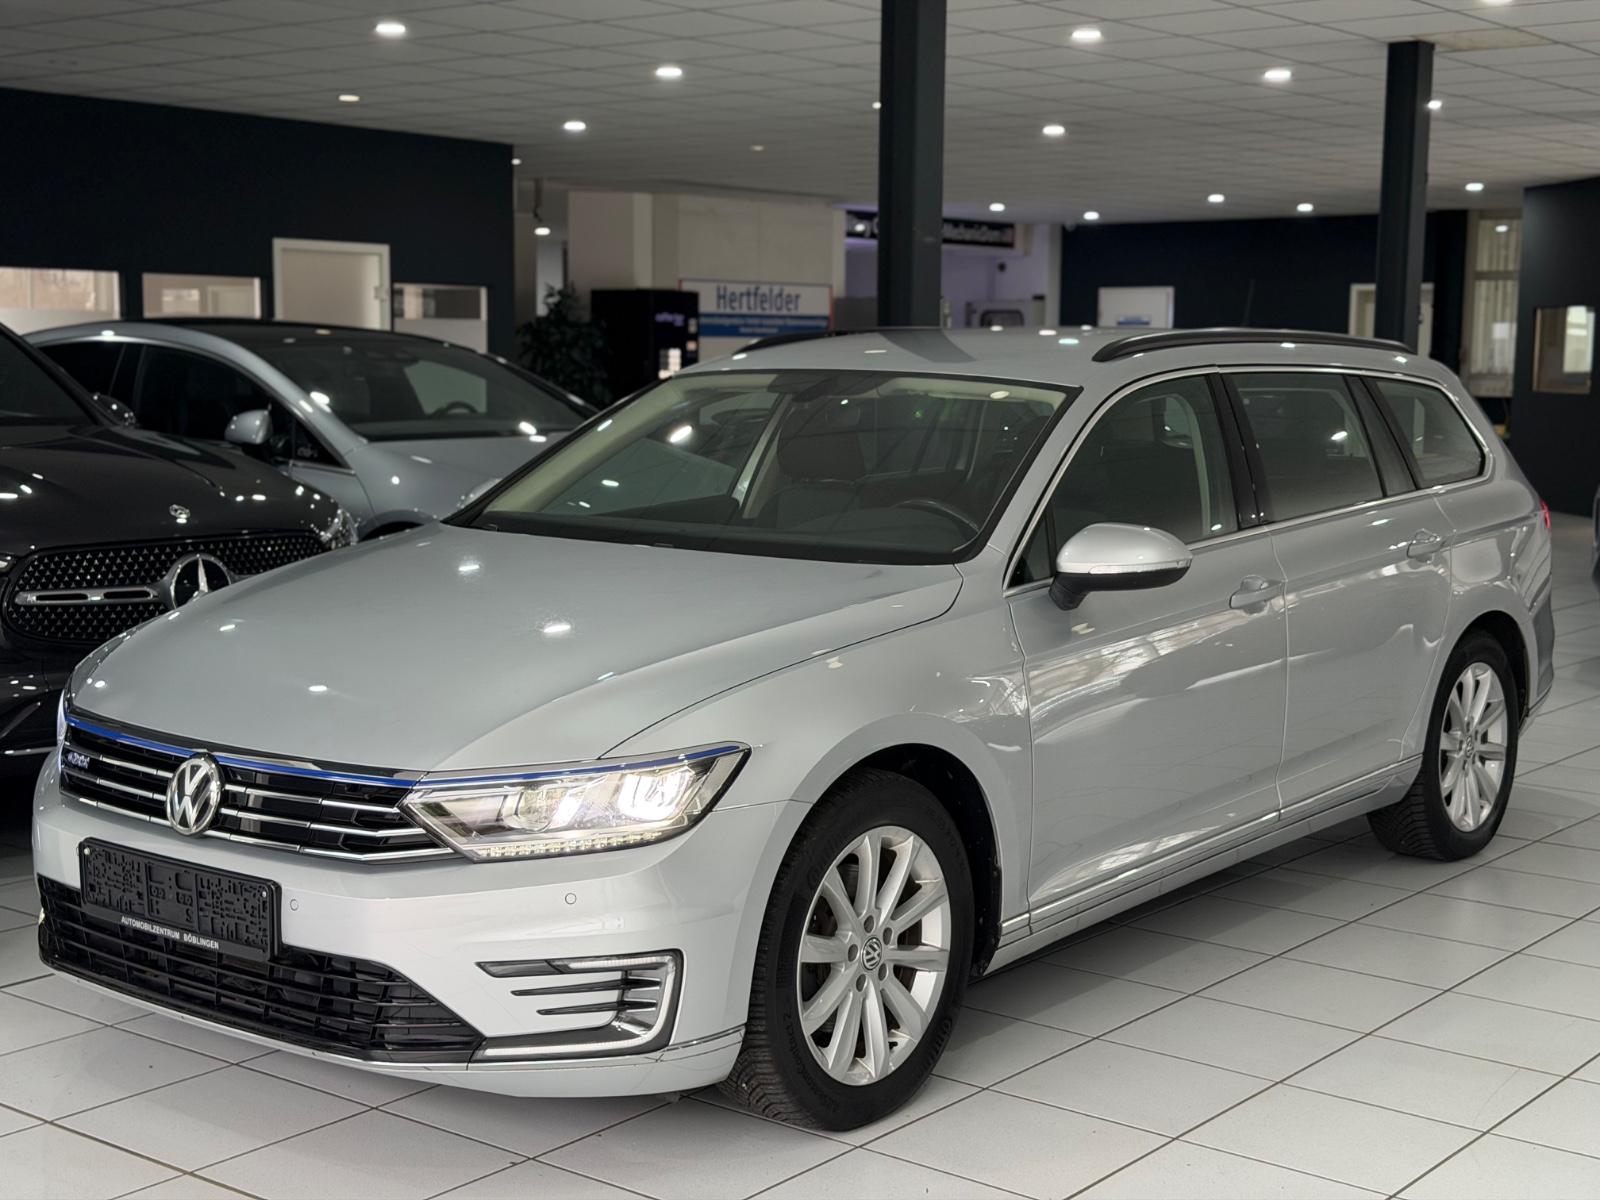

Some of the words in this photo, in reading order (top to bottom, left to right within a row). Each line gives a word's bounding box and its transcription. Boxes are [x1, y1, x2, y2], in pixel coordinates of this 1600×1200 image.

[715, 285, 801, 312] Hertfelder
[121, 916, 180, 939] AUTOMOBILZENTRUM
[183, 933, 219, 949] BÖBLINGEN
